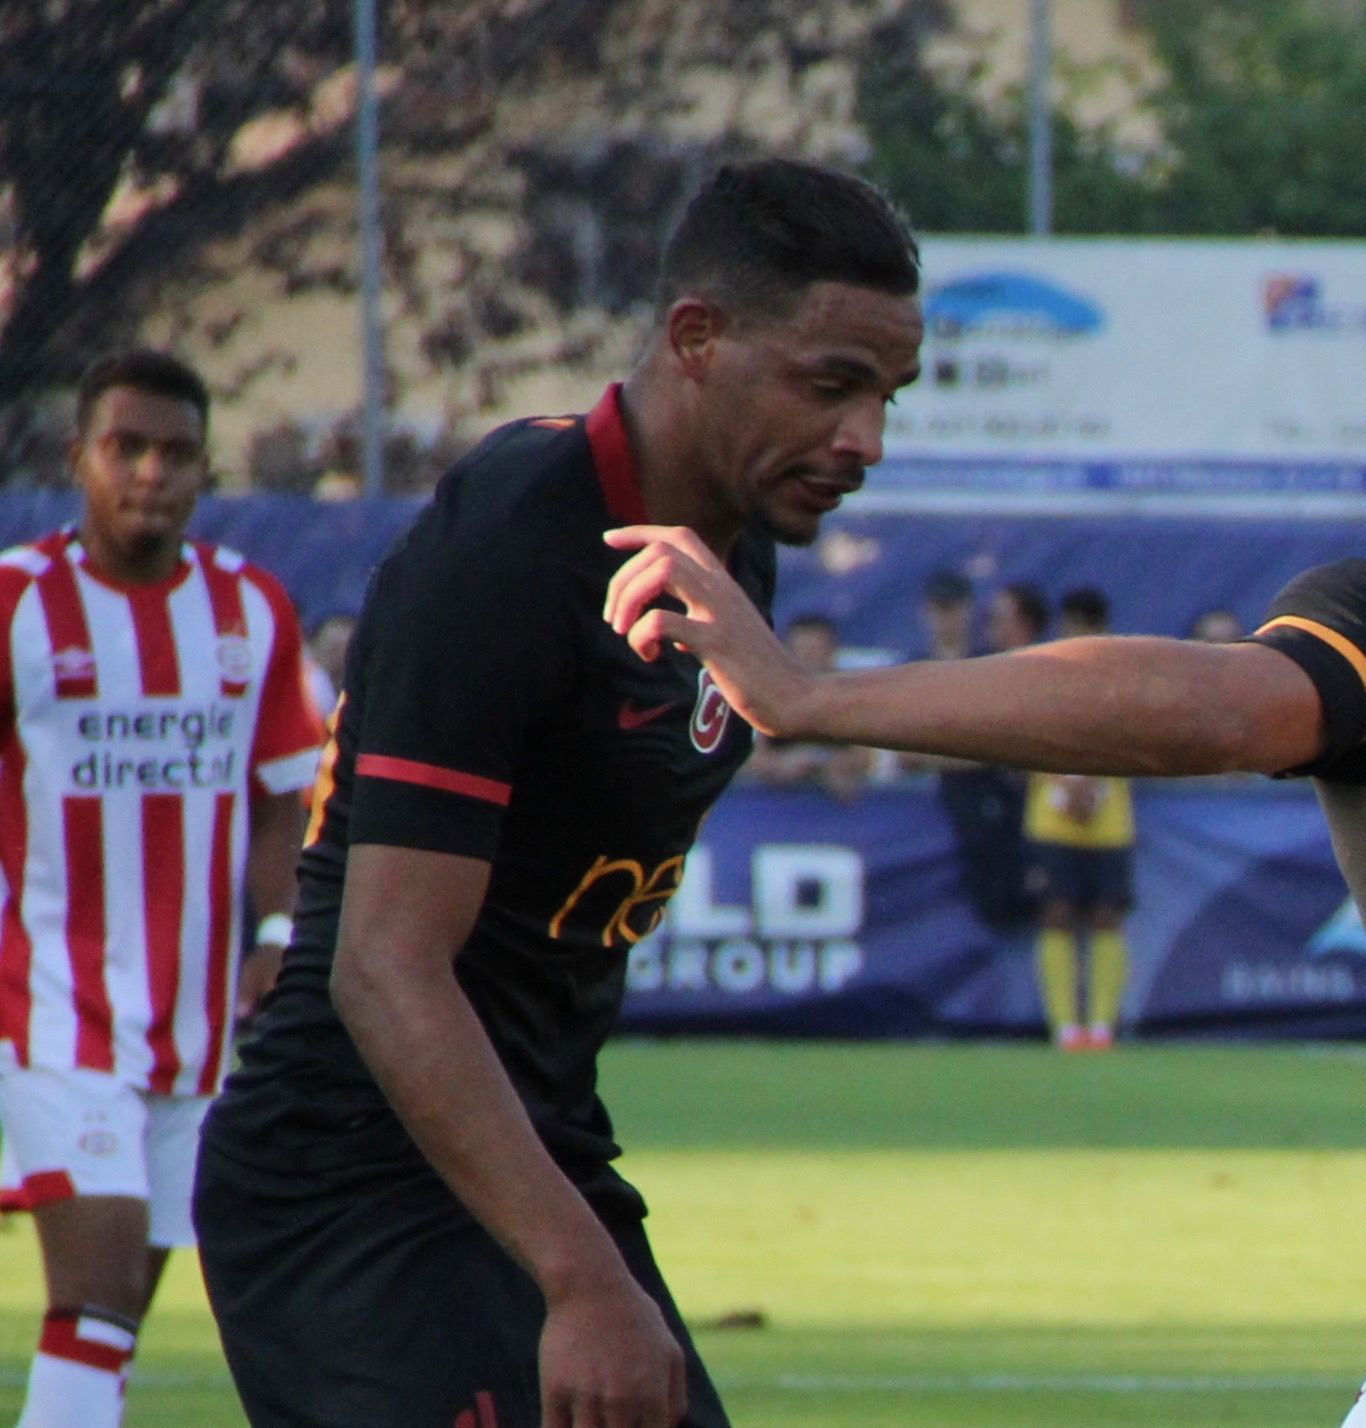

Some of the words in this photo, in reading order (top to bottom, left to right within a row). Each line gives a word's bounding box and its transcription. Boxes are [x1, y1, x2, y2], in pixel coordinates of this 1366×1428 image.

[78, 702, 236, 750] energie
[549, 853, 685, 948] ne
[622, 938, 862, 994] GROUP
